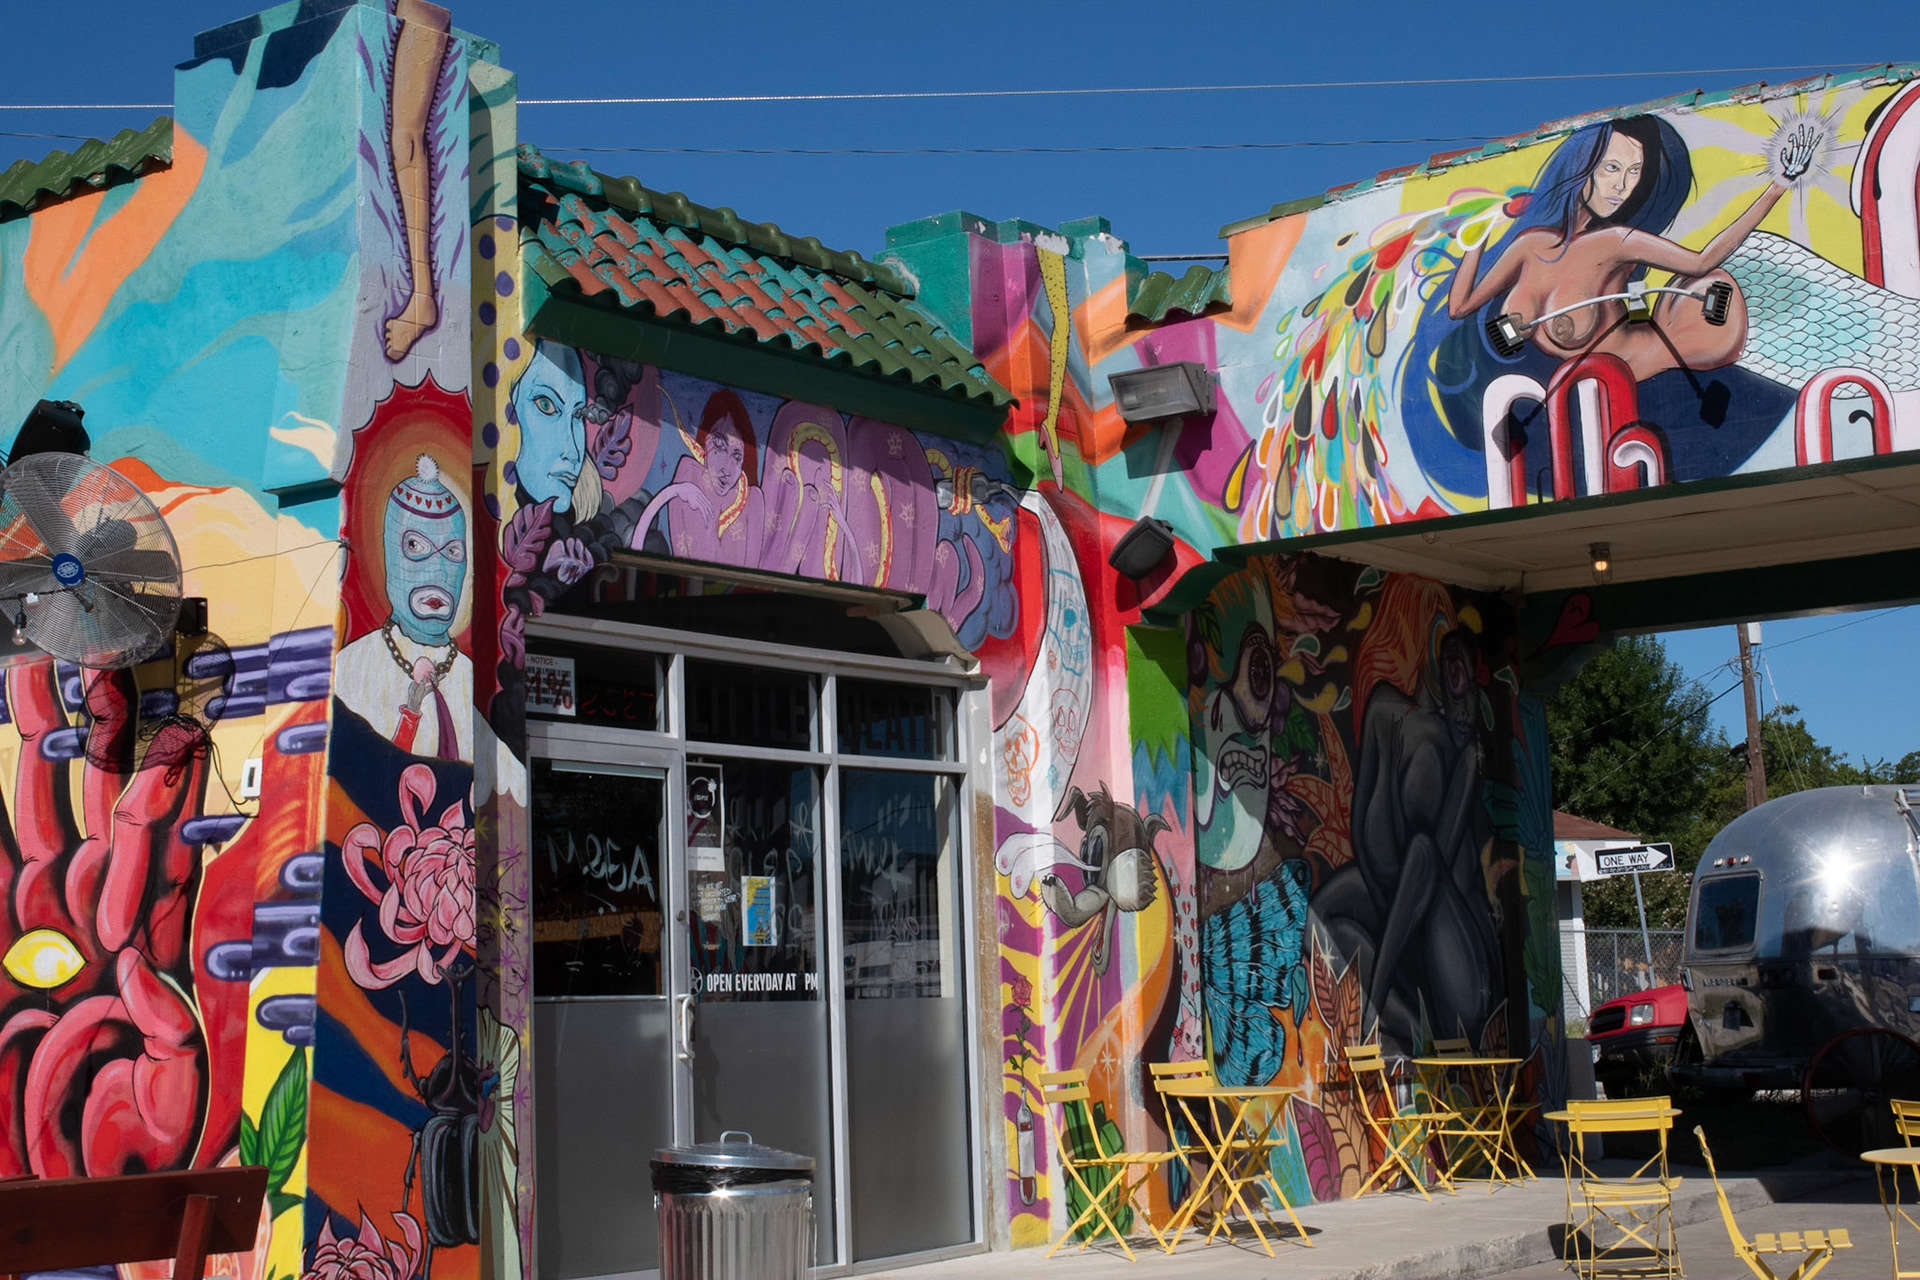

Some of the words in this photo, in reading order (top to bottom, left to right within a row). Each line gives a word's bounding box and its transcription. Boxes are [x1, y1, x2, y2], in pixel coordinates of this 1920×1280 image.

[530, 656, 554, 666] NOTICE
[1603, 855, 1624, 867] ONE
[1628, 853, 1649, 864] WAY
[706, 973, 732, 992] OPEN
[735, 972, 785, 992] EVERYDAY
[785, 972, 797, 991] AT
[805, 972, 818, 991] PM
